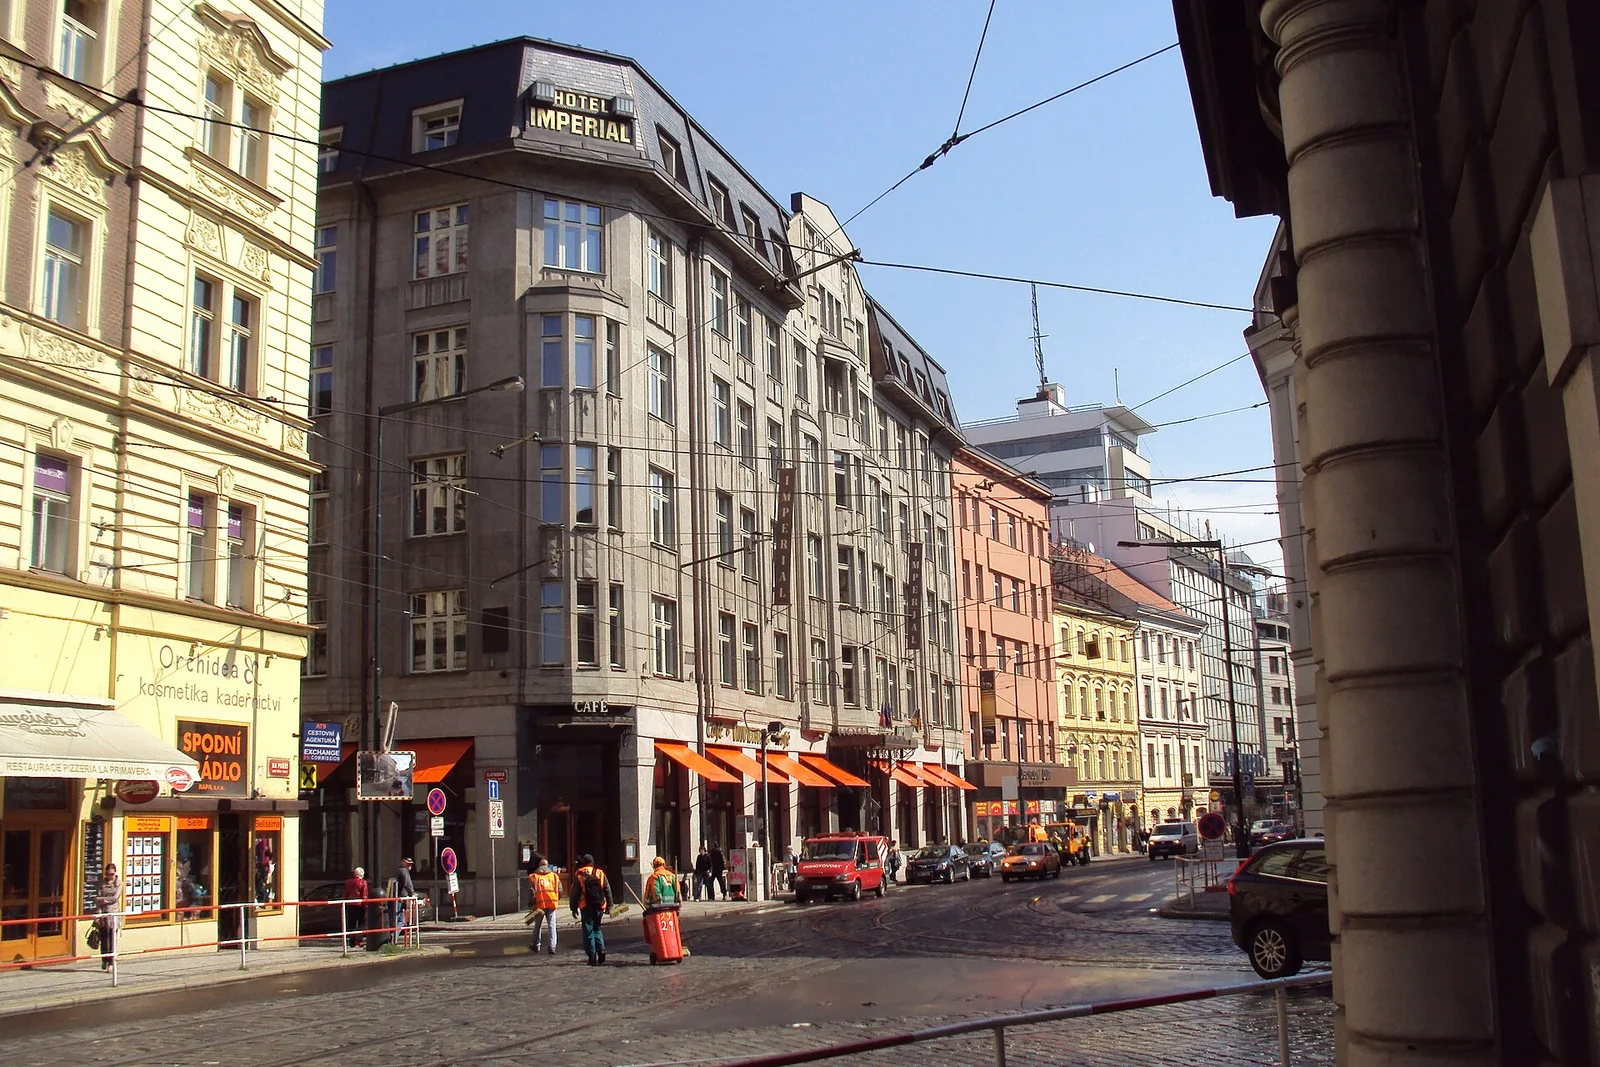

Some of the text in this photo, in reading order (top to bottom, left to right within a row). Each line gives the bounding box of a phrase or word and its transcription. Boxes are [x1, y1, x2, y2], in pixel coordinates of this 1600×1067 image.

[554, 90, 609, 114] HOTEL
[530, 106, 631, 144] IMPERIAL
[779, 475, 791, 599] IMPERIAL
[911, 548, 920, 645] IMPERIAL
[159, 644, 240, 679] Orchidea
[138, 676, 282, 712] kosmetika kadeřnictví
[574, 698, 609, 713] CAFÉ
[183, 730, 242, 755] SPODNÍ
[307, 729, 335, 737] CESTOVNÍ
[5, 761, 152, 776] RESTAURACE PIZZERIA LA PRIMAVERA
[661, 920, 674, 932] 29
